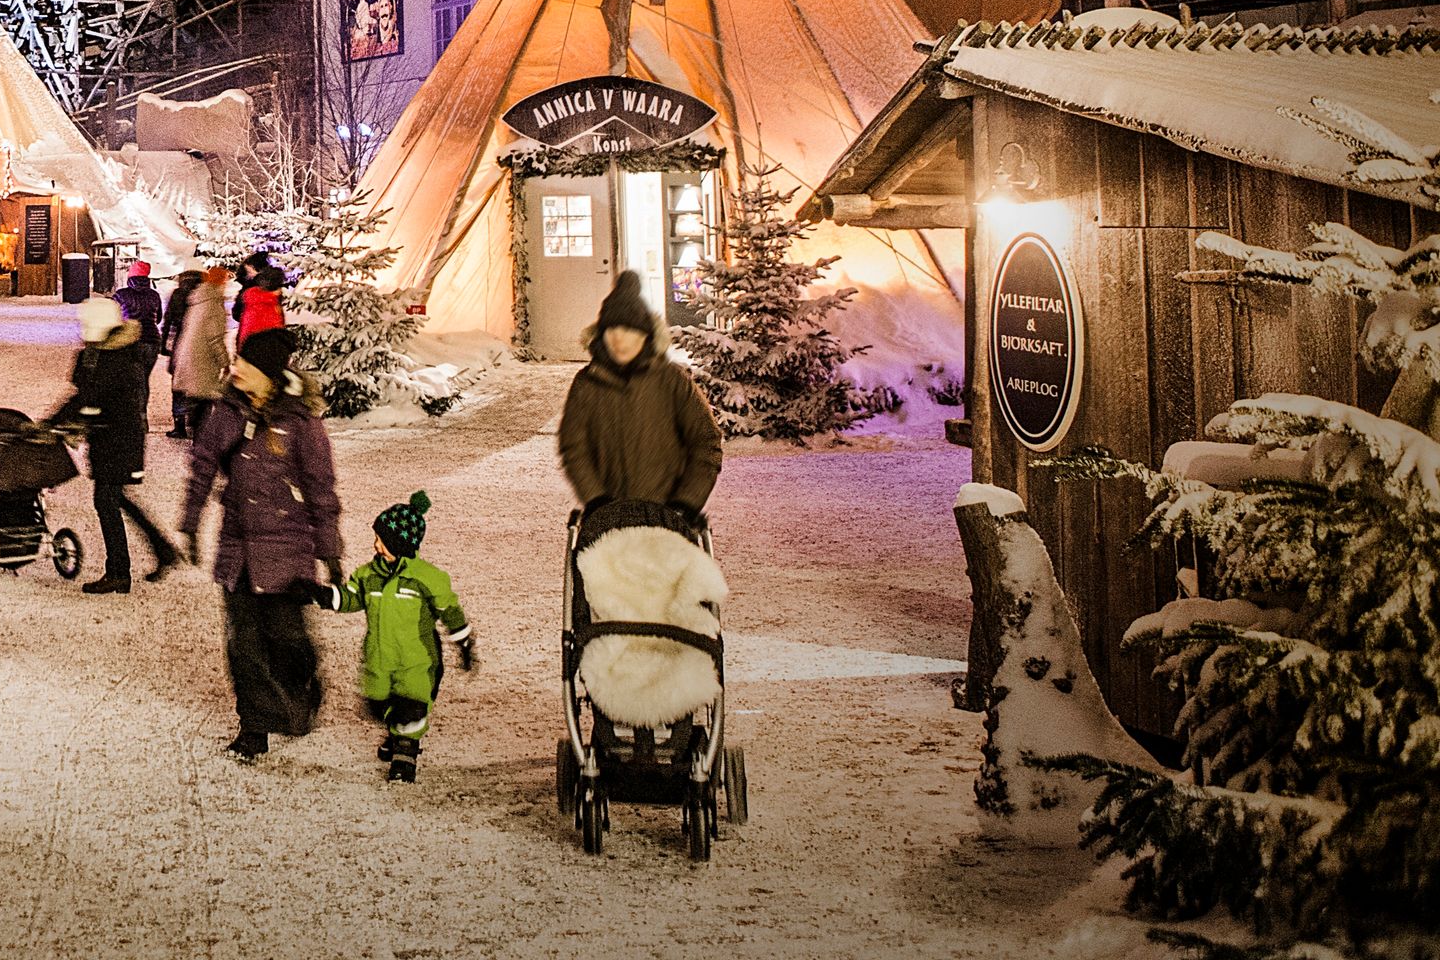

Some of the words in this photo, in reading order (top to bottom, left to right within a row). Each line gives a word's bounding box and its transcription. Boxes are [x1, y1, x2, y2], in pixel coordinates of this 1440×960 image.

[532, 90, 597, 129] ANNICA
[603, 89, 614, 110] V
[622, 90, 684, 126] WAARA
[593, 135, 631, 153] Konst
[1000, 293, 1065, 314] YLLEFILTAR
[1026, 317, 1036, 332] &
[1006, 376, 1059, 398] ARJEPLOG
